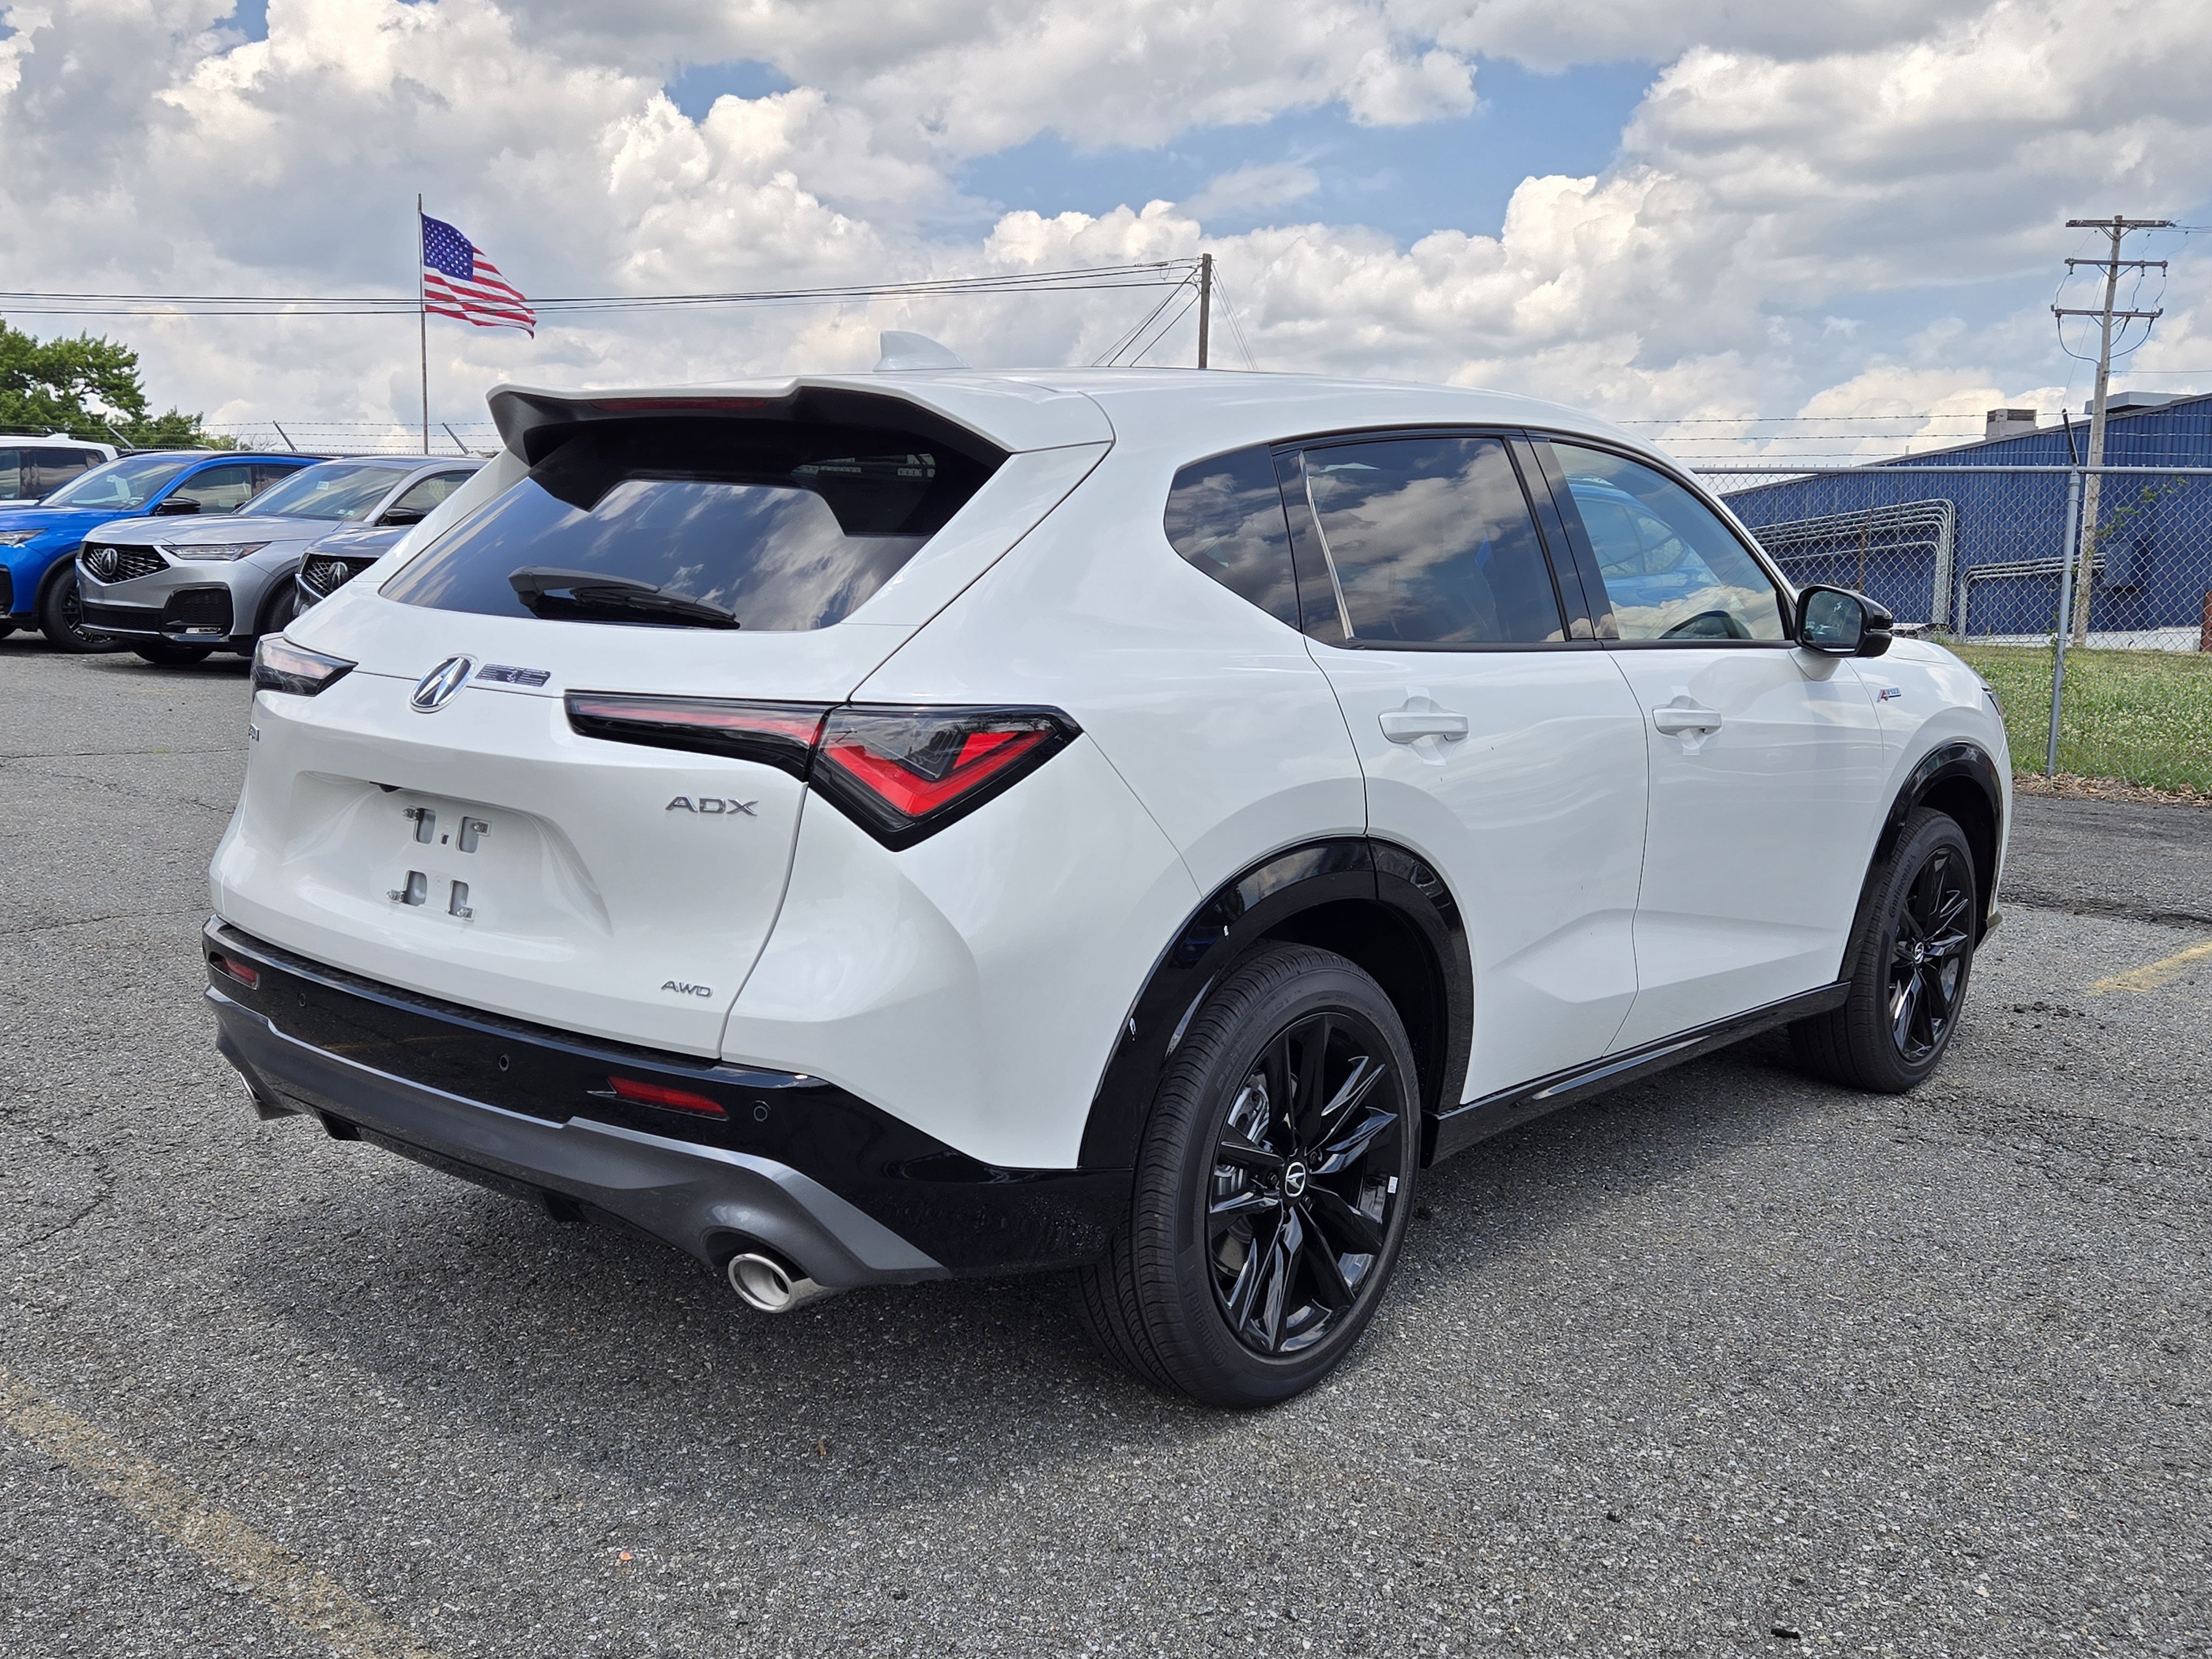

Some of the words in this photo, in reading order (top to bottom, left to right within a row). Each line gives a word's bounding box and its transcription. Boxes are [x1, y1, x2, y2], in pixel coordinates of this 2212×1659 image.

[665, 795, 759, 816] ADX
[1888, 859, 1913, 918] Continental
[661, 980, 713, 998] AWD
[1184, 1290, 1227, 1369] Continental
